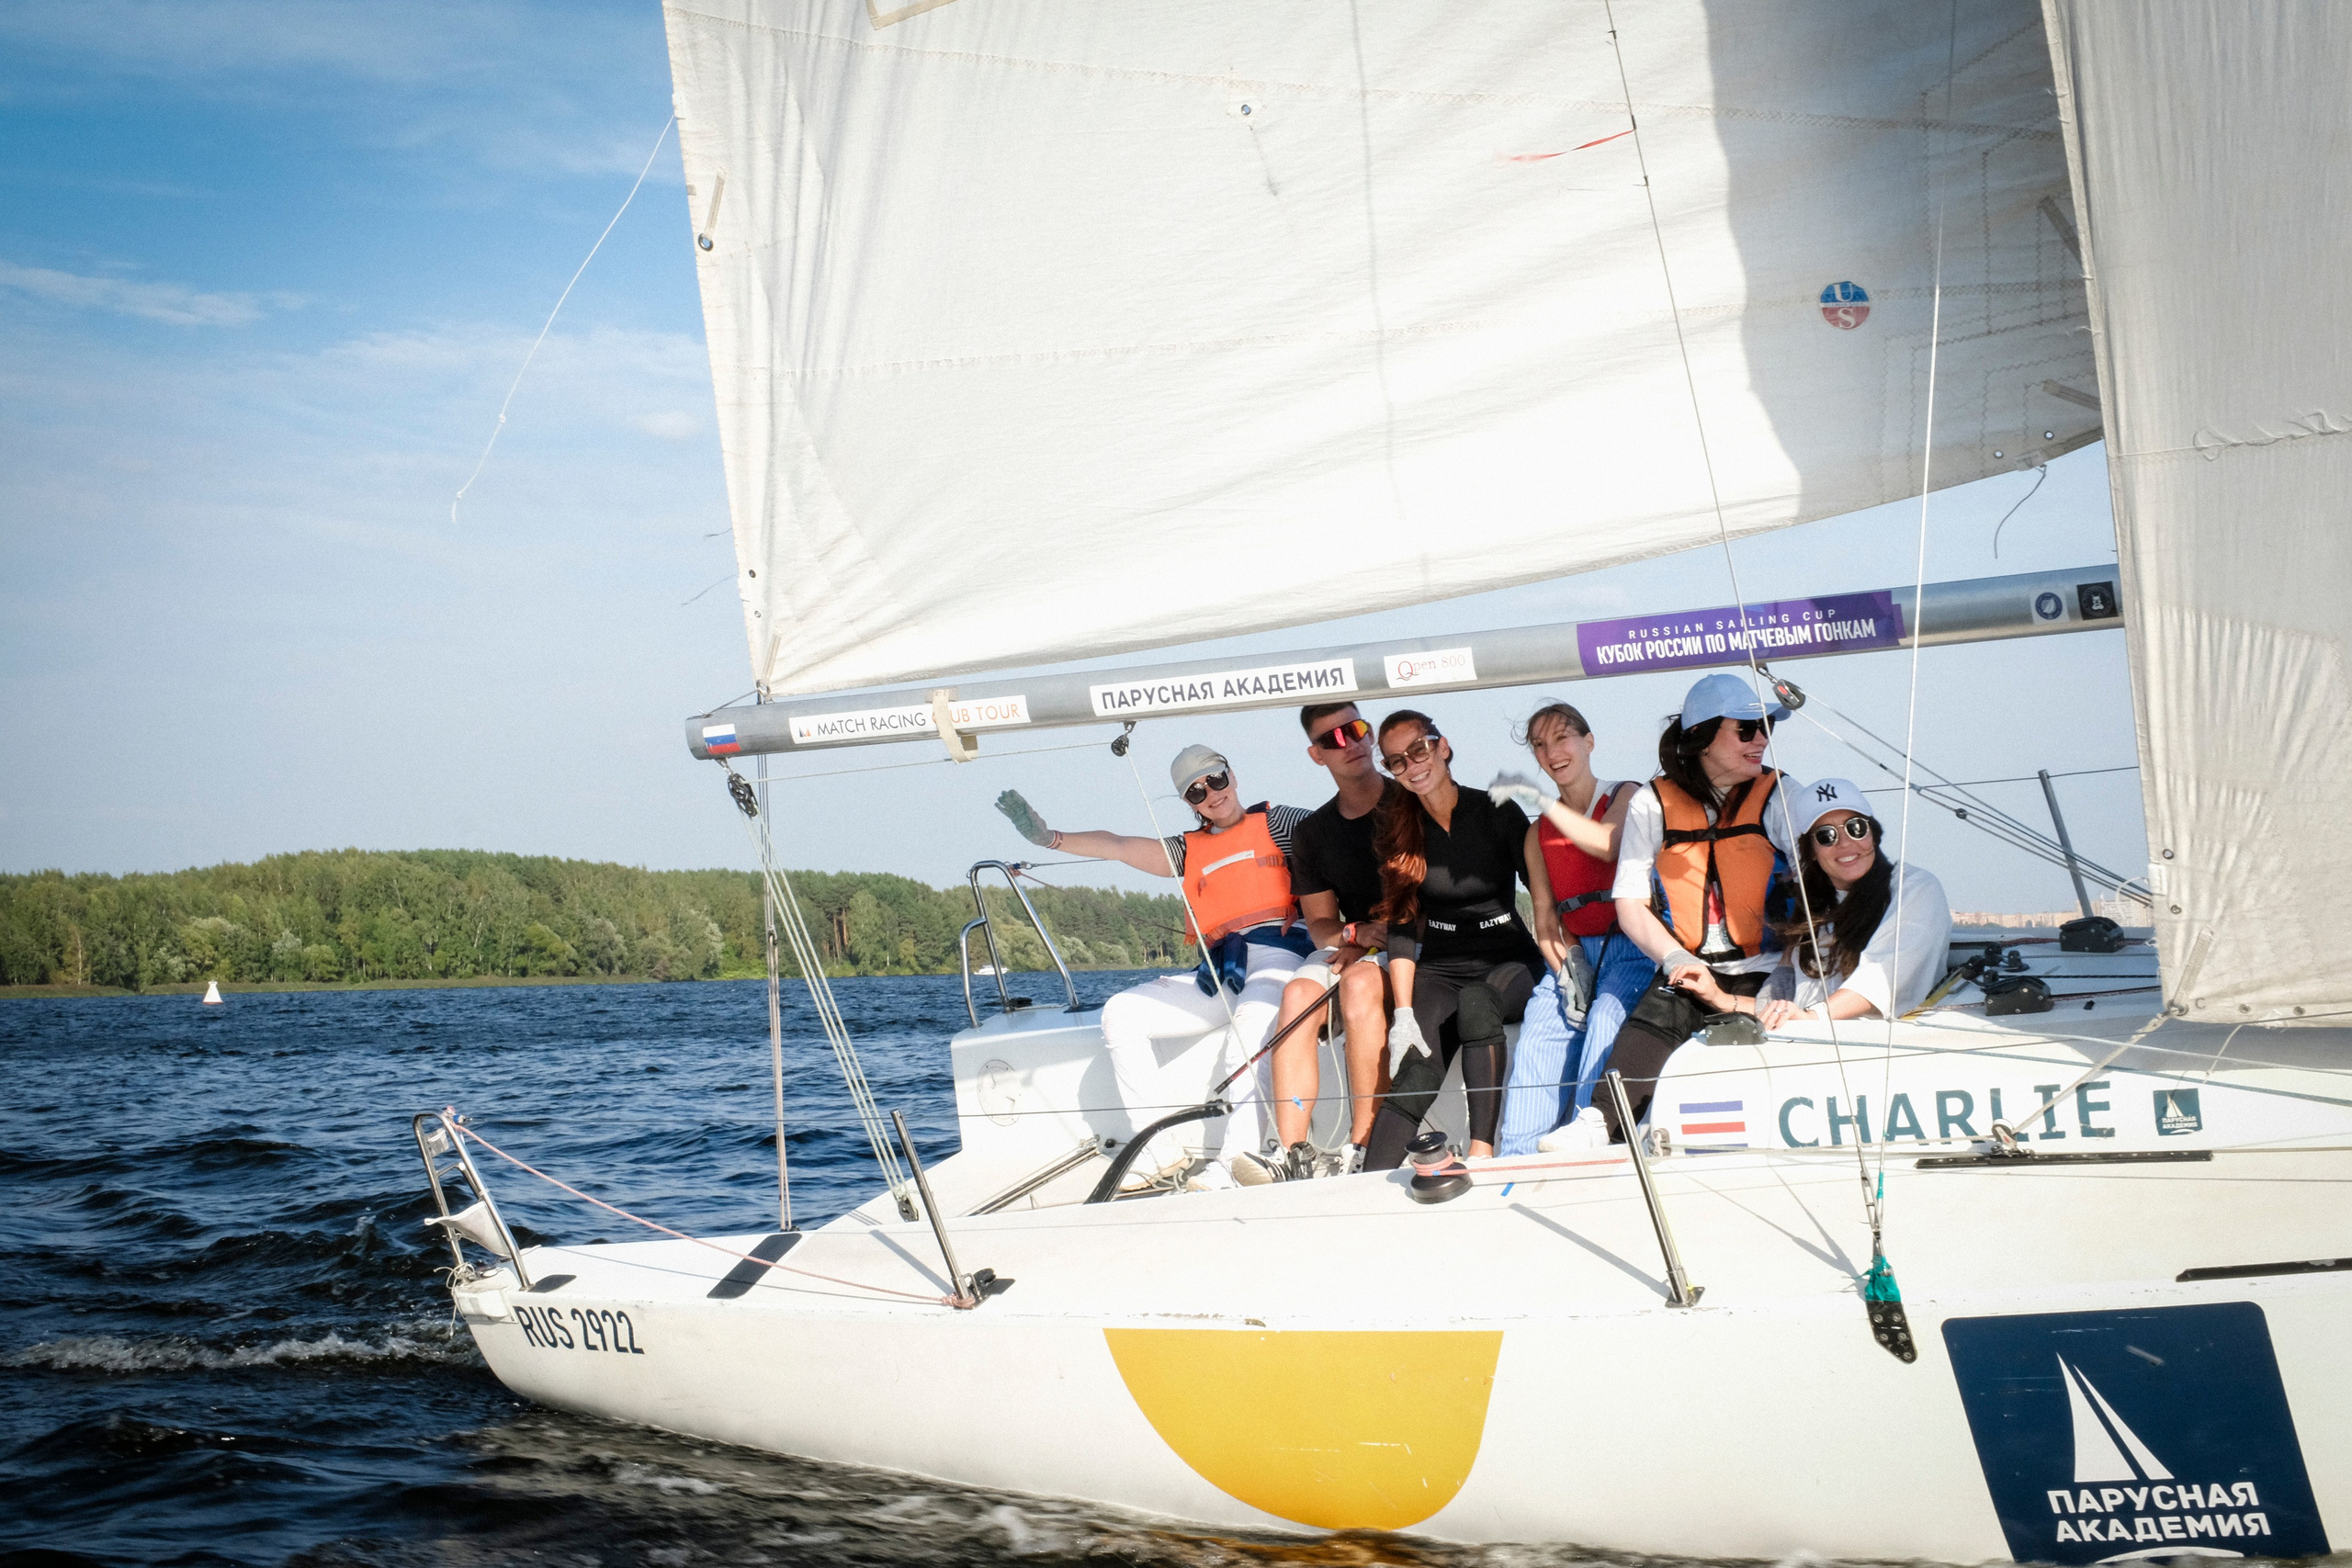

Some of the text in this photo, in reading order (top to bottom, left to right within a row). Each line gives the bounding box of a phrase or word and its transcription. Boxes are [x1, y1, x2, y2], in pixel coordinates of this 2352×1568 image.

[1834, 283, 1854, 302] U
[1838, 307, 1856, 329] S
[1628, 609, 1836, 639] RUSSIAN SAILING CUP
[1596, 618, 1876, 664] КУБОК РОССИИ ПО МАТЧЕВЫМ ГОНКАМ
[1441, 654, 1465, 668] 800
[1102, 667, 1345, 709] ПАРУСНАЯ АКАДЕМИЯ
[817, 716, 865, 736] MATCH
[870, 712, 926, 730] RACING
[976, 704, 1021, 721] TOUR
[1815, 783, 1838, 802] NY
[1428, 919, 1457, 931] EAZYWAY
[1479, 912, 1512, 930] EAZYWAY
[1778, 1080, 2116, 1147] CHARLIE
[512, 1305, 645, 1354] RUS 2922
[2047, 1482, 2260, 1514] ПАРУСНАЯ
[2056, 1512, 2272, 1542] АКАДЕМИЯ
